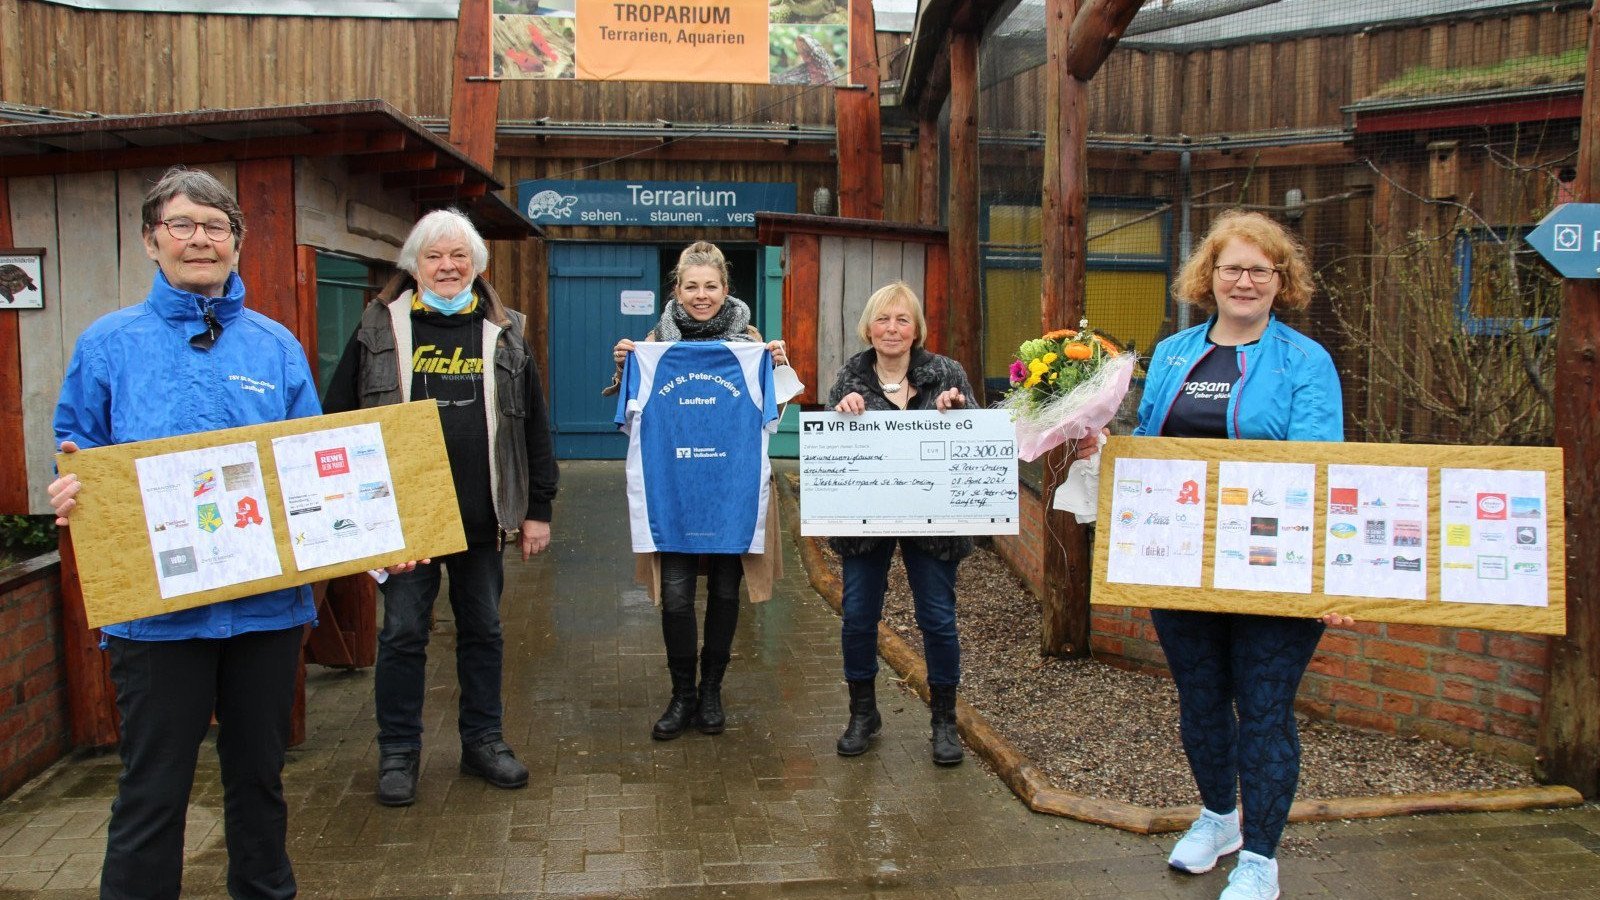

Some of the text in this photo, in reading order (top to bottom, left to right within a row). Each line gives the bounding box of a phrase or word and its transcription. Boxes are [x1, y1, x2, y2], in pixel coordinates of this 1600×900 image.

[613, 3, 731, 25] TROPARIUM
[599, 26, 746, 47] Terrarien, Aquarien
[626, 185, 737, 207] Terrarium
[581, 210, 622, 221] sehen
[650, 210, 703, 222] staunen
[727, 211, 755, 222] vers
[659, 372, 741, 398] TSV St. Peter-Ording
[679, 396, 717, 405] Lauftreff
[827, 419, 973, 431] VR Bank Westküste eG
[320, 453, 343, 463] REWE
